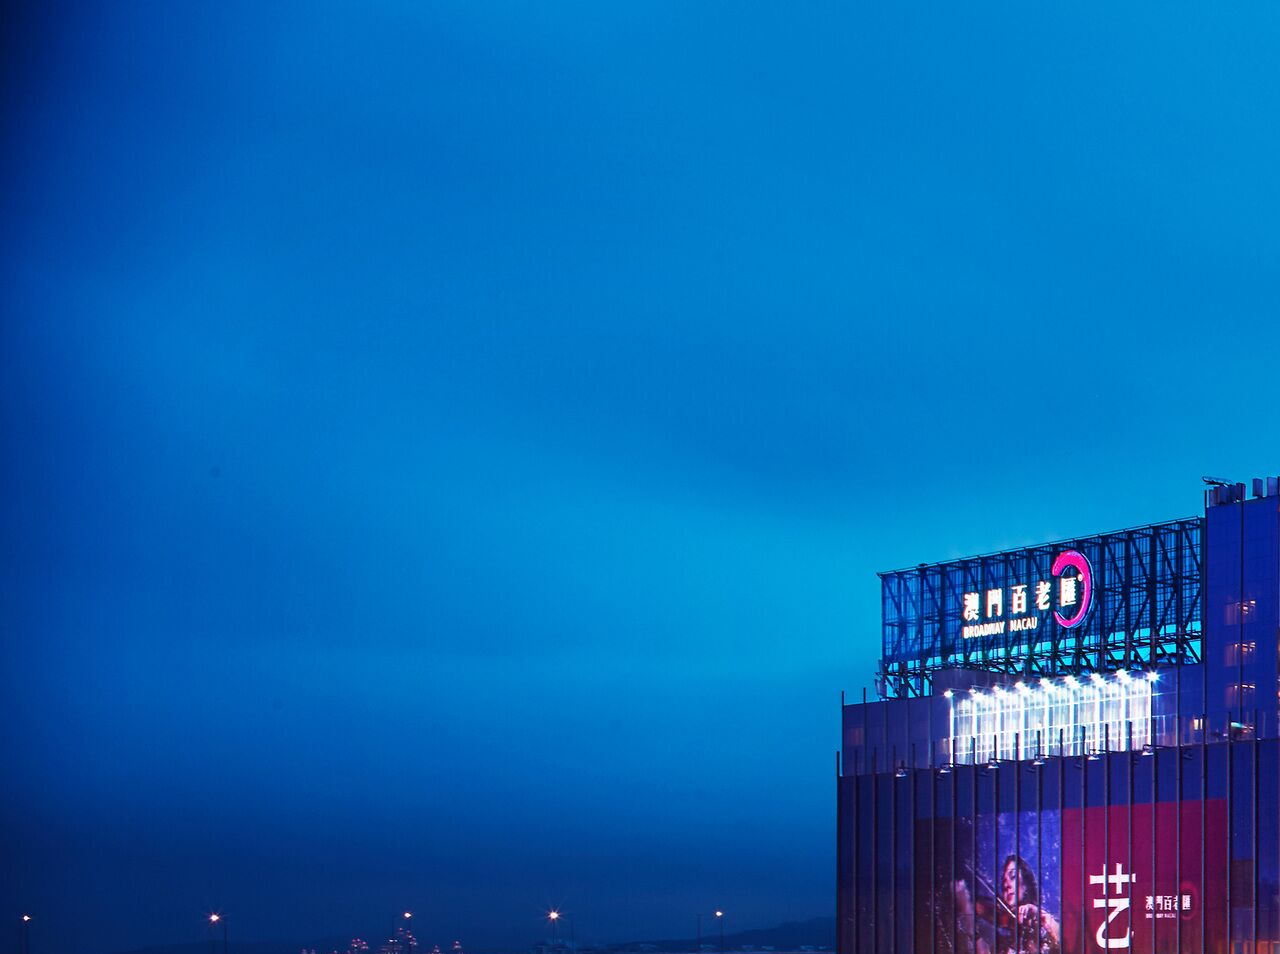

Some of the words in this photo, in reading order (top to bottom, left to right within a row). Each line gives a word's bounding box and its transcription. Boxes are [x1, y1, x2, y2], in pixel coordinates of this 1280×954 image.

[963, 577, 1077, 621] 澳門百老匯
[963, 621, 1006, 639] BROADWAY
[1010, 616, 1038, 632] MACAU
